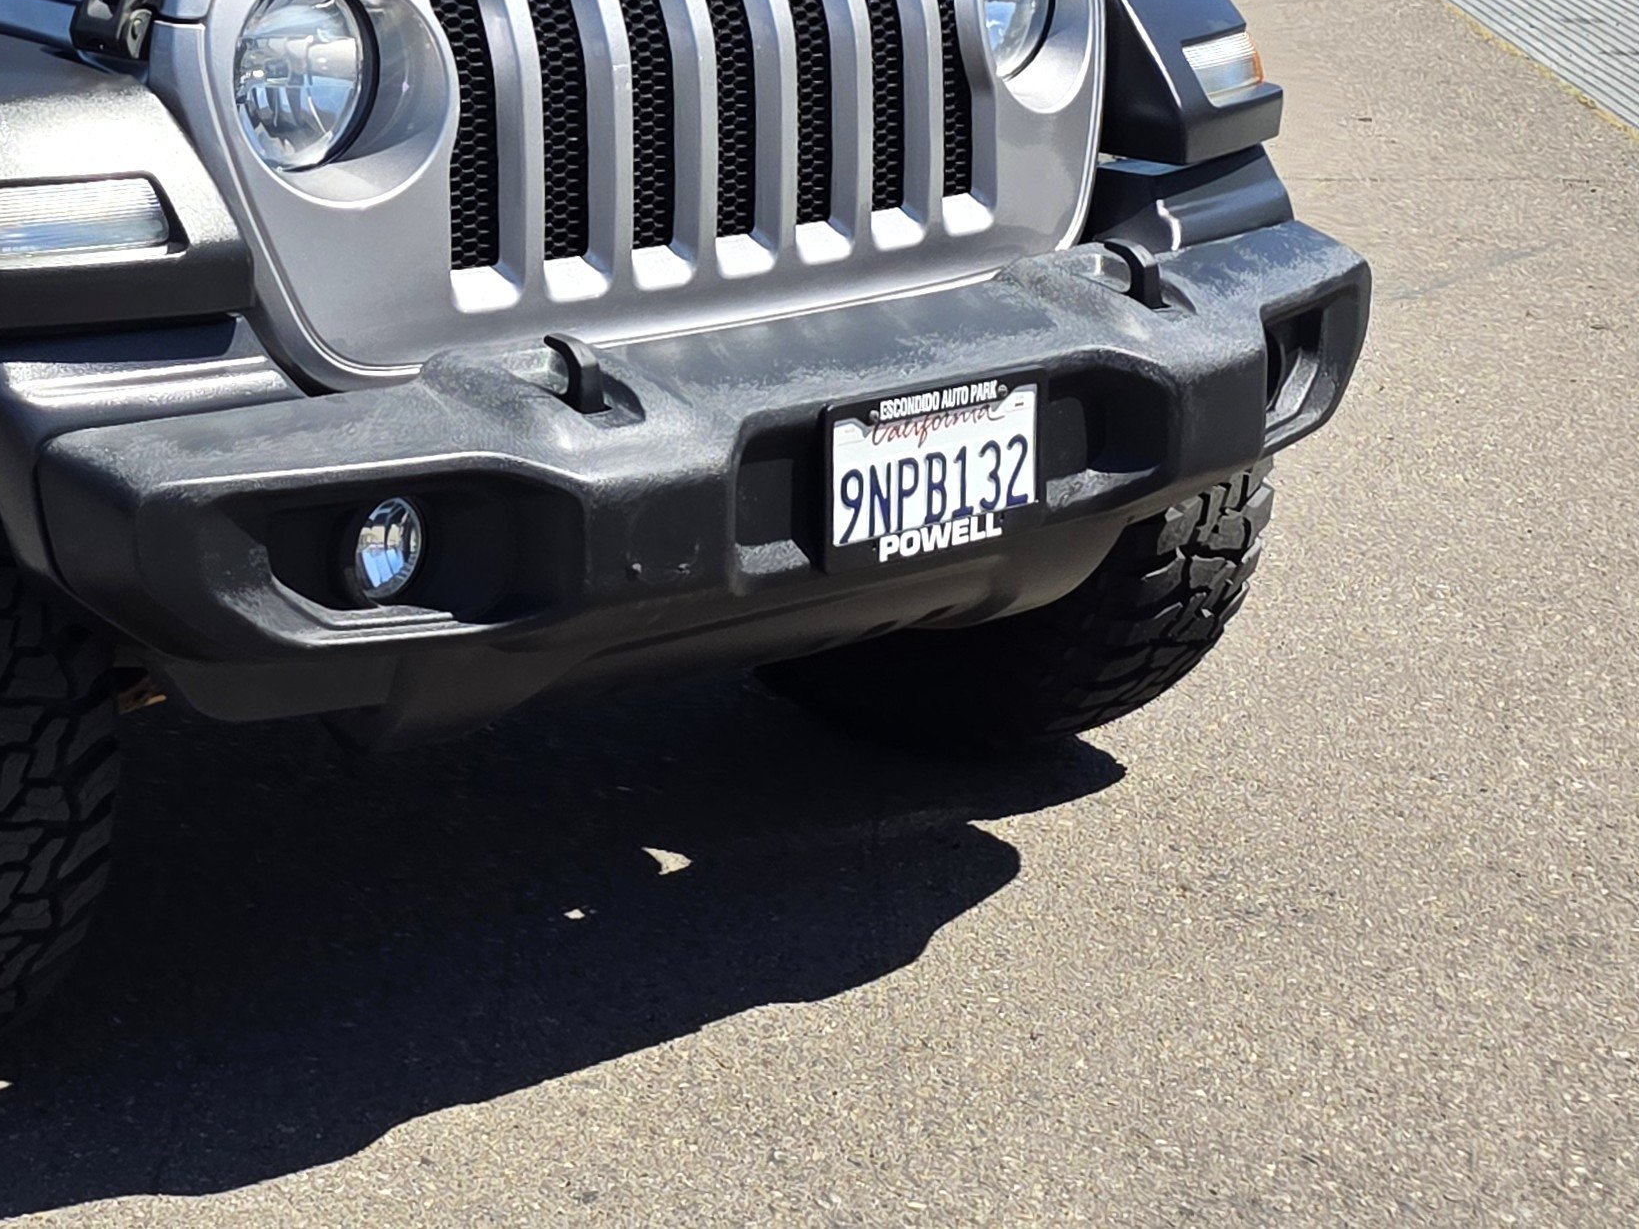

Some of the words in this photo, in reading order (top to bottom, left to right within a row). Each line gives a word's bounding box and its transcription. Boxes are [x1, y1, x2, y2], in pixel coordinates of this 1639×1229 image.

[879, 390, 940, 421] ESCONDIDO
[941, 386, 969, 409] AUTO
[970, 380, 998, 404] PARK
[869, 403, 1005, 448] California
[839, 433, 1030, 545] 9NPB132
[879, 512, 1003, 563] POWELL
